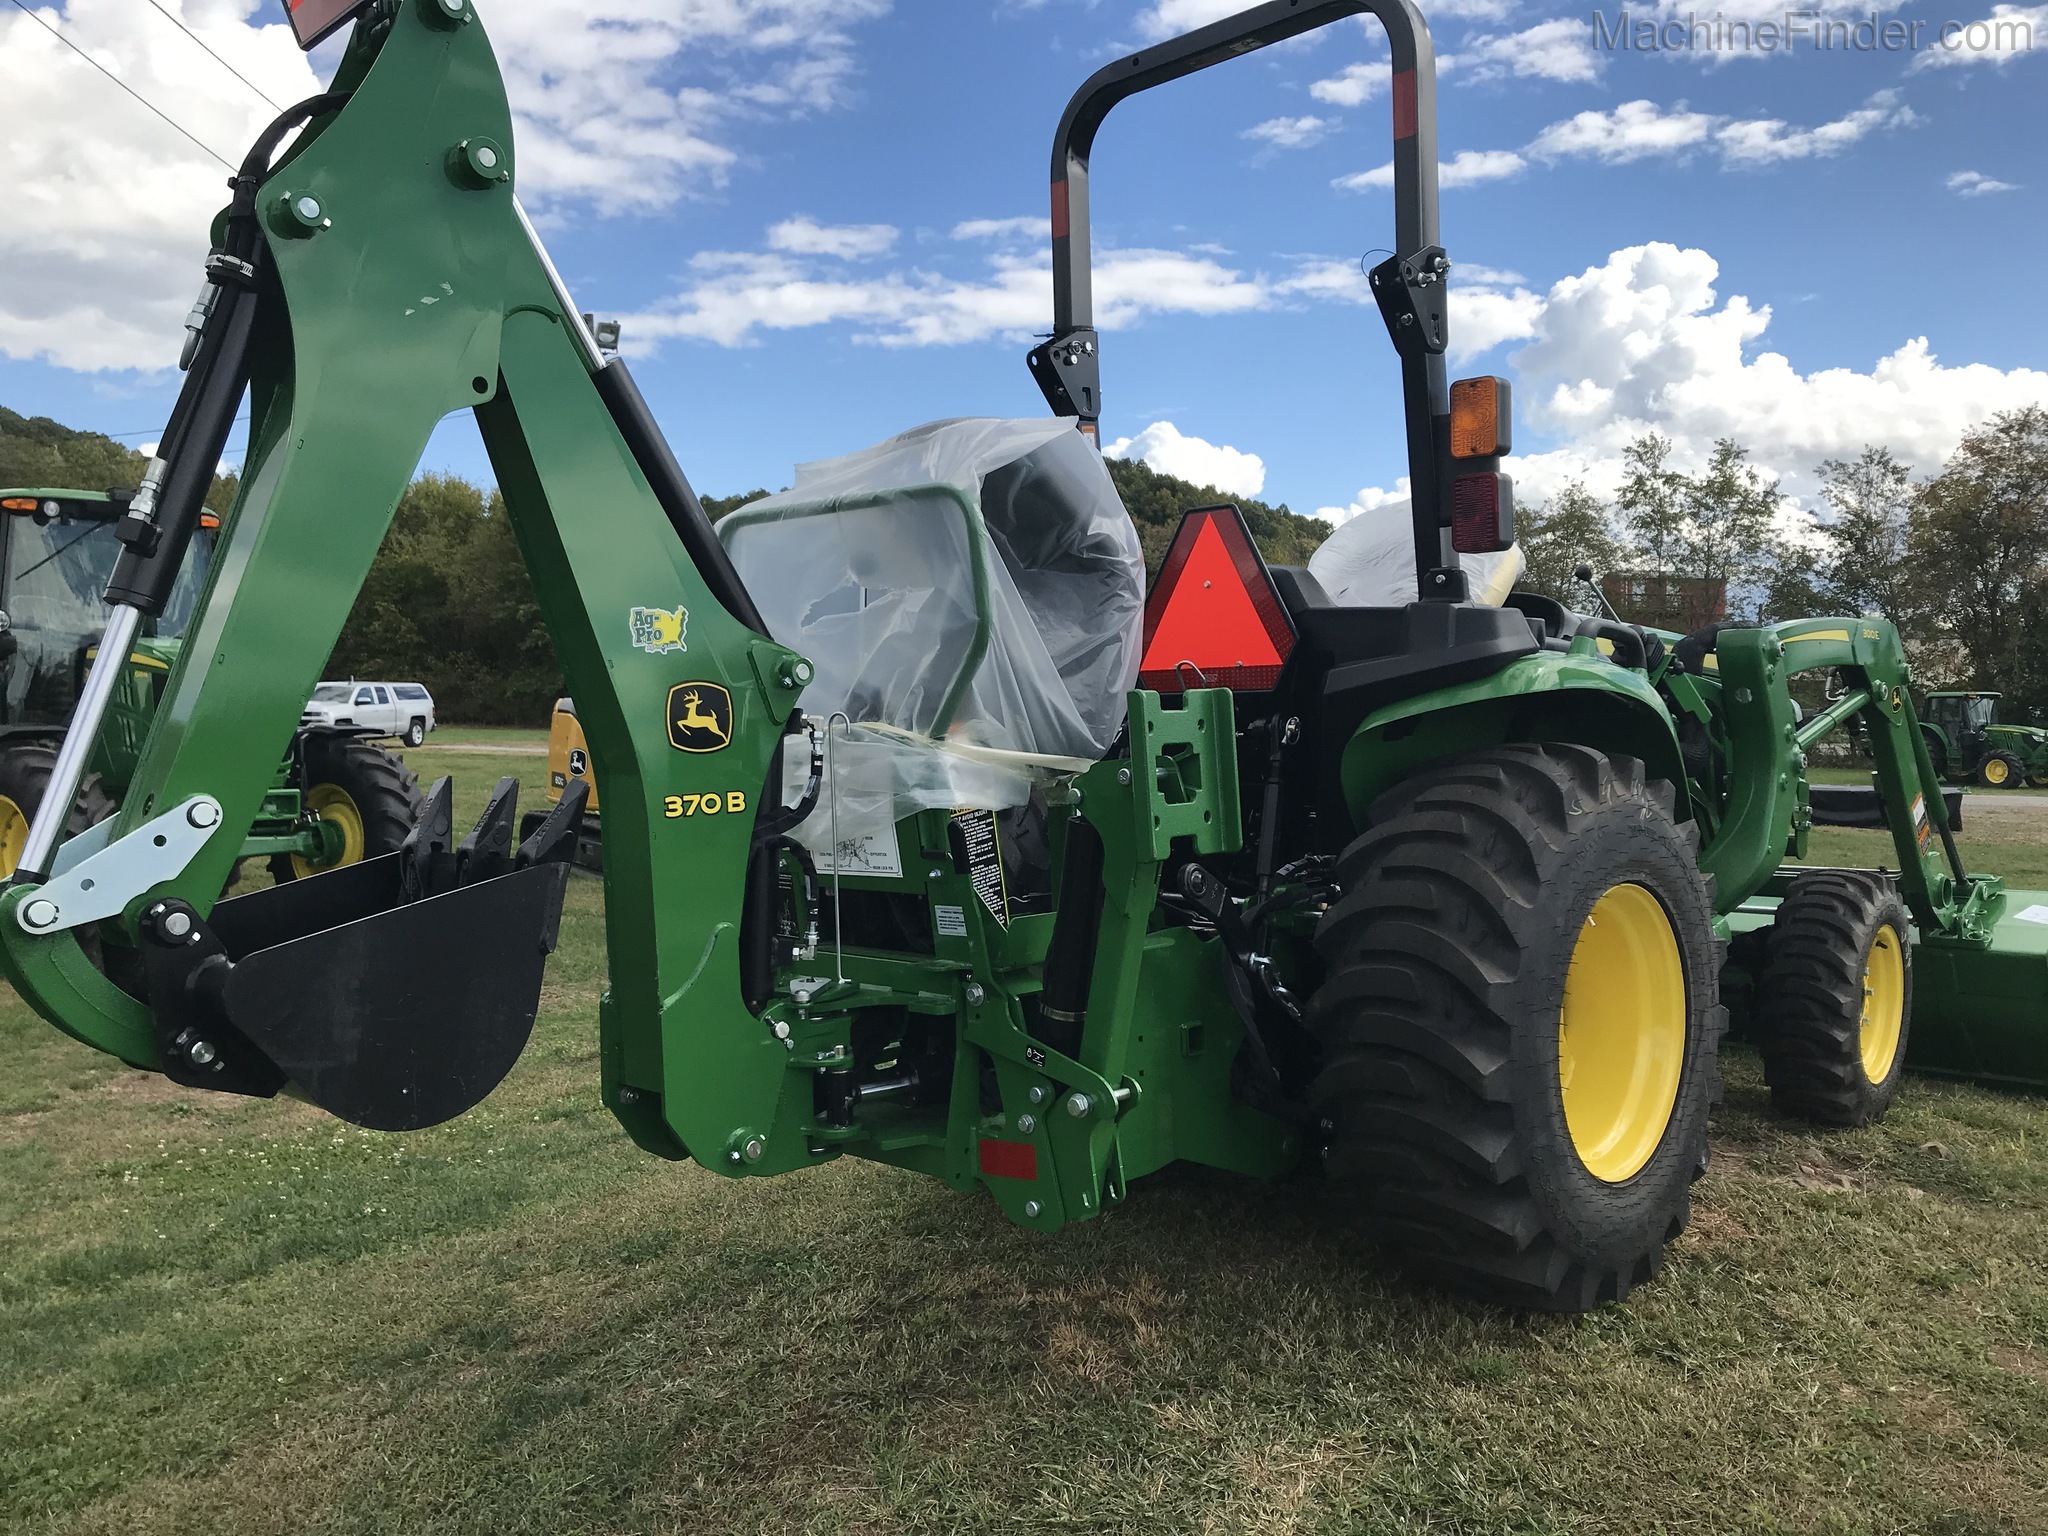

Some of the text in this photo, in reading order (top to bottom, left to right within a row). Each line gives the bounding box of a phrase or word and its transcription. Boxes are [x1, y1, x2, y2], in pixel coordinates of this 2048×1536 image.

[635, 628, 662, 644] Pro
[664, 791, 746, 818] 370 B
